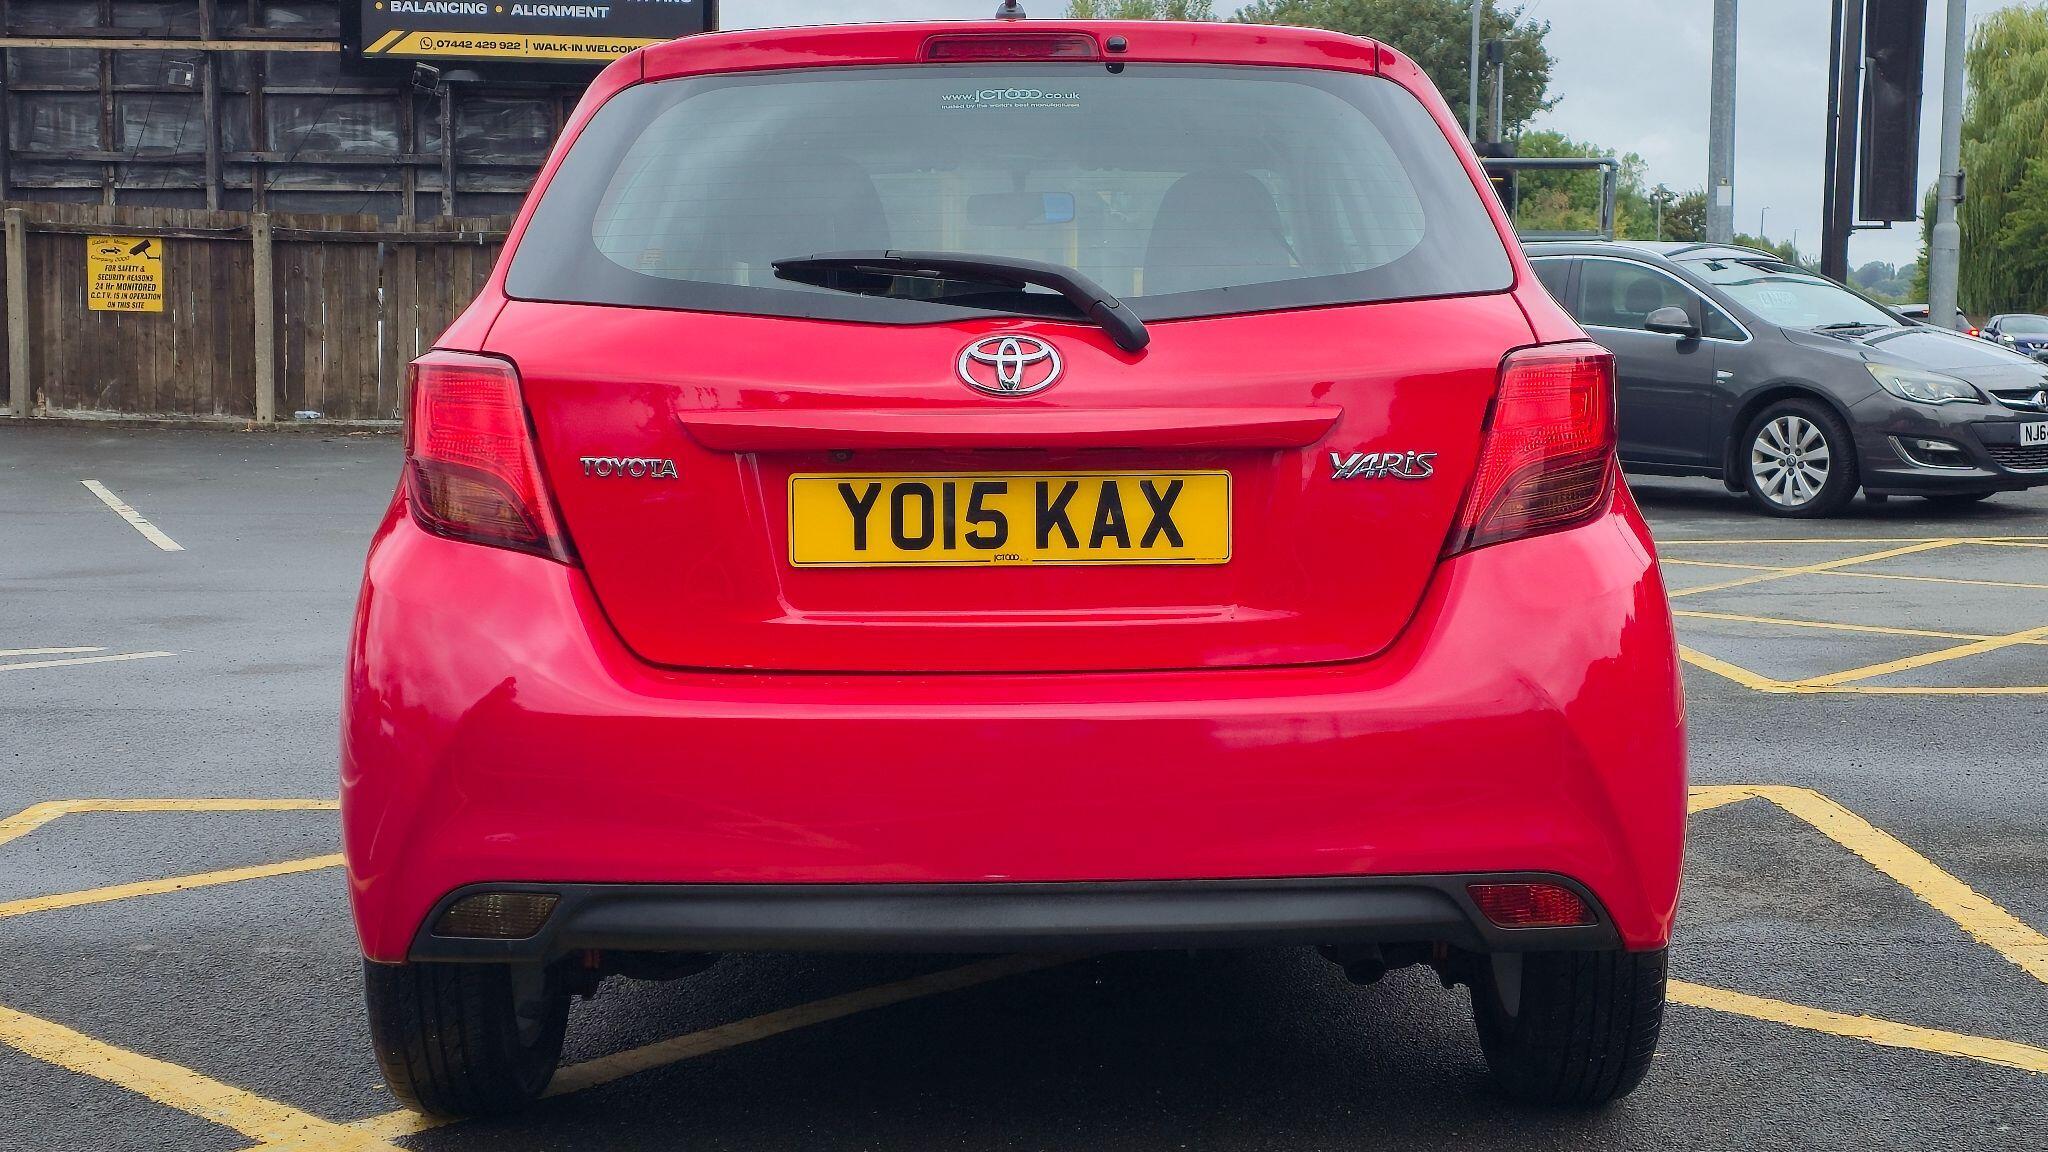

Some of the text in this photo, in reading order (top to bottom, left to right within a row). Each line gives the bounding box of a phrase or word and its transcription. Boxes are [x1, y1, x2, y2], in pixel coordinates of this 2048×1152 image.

[390, 0, 610, 19] BALANCING ALIGNMENT
[436, 40, 644, 54] 07442 429 922 WALK-IN WELCOM
[113, 292, 120, 300] IS
[121, 292, 128, 300] IN
[115, 283, 157, 291] MONITORED
[2025, 424, 2048, 442] NJ6
[579, 456, 679, 479] TOYOTA
[837, 479, 1184, 551] YO15 KAX
